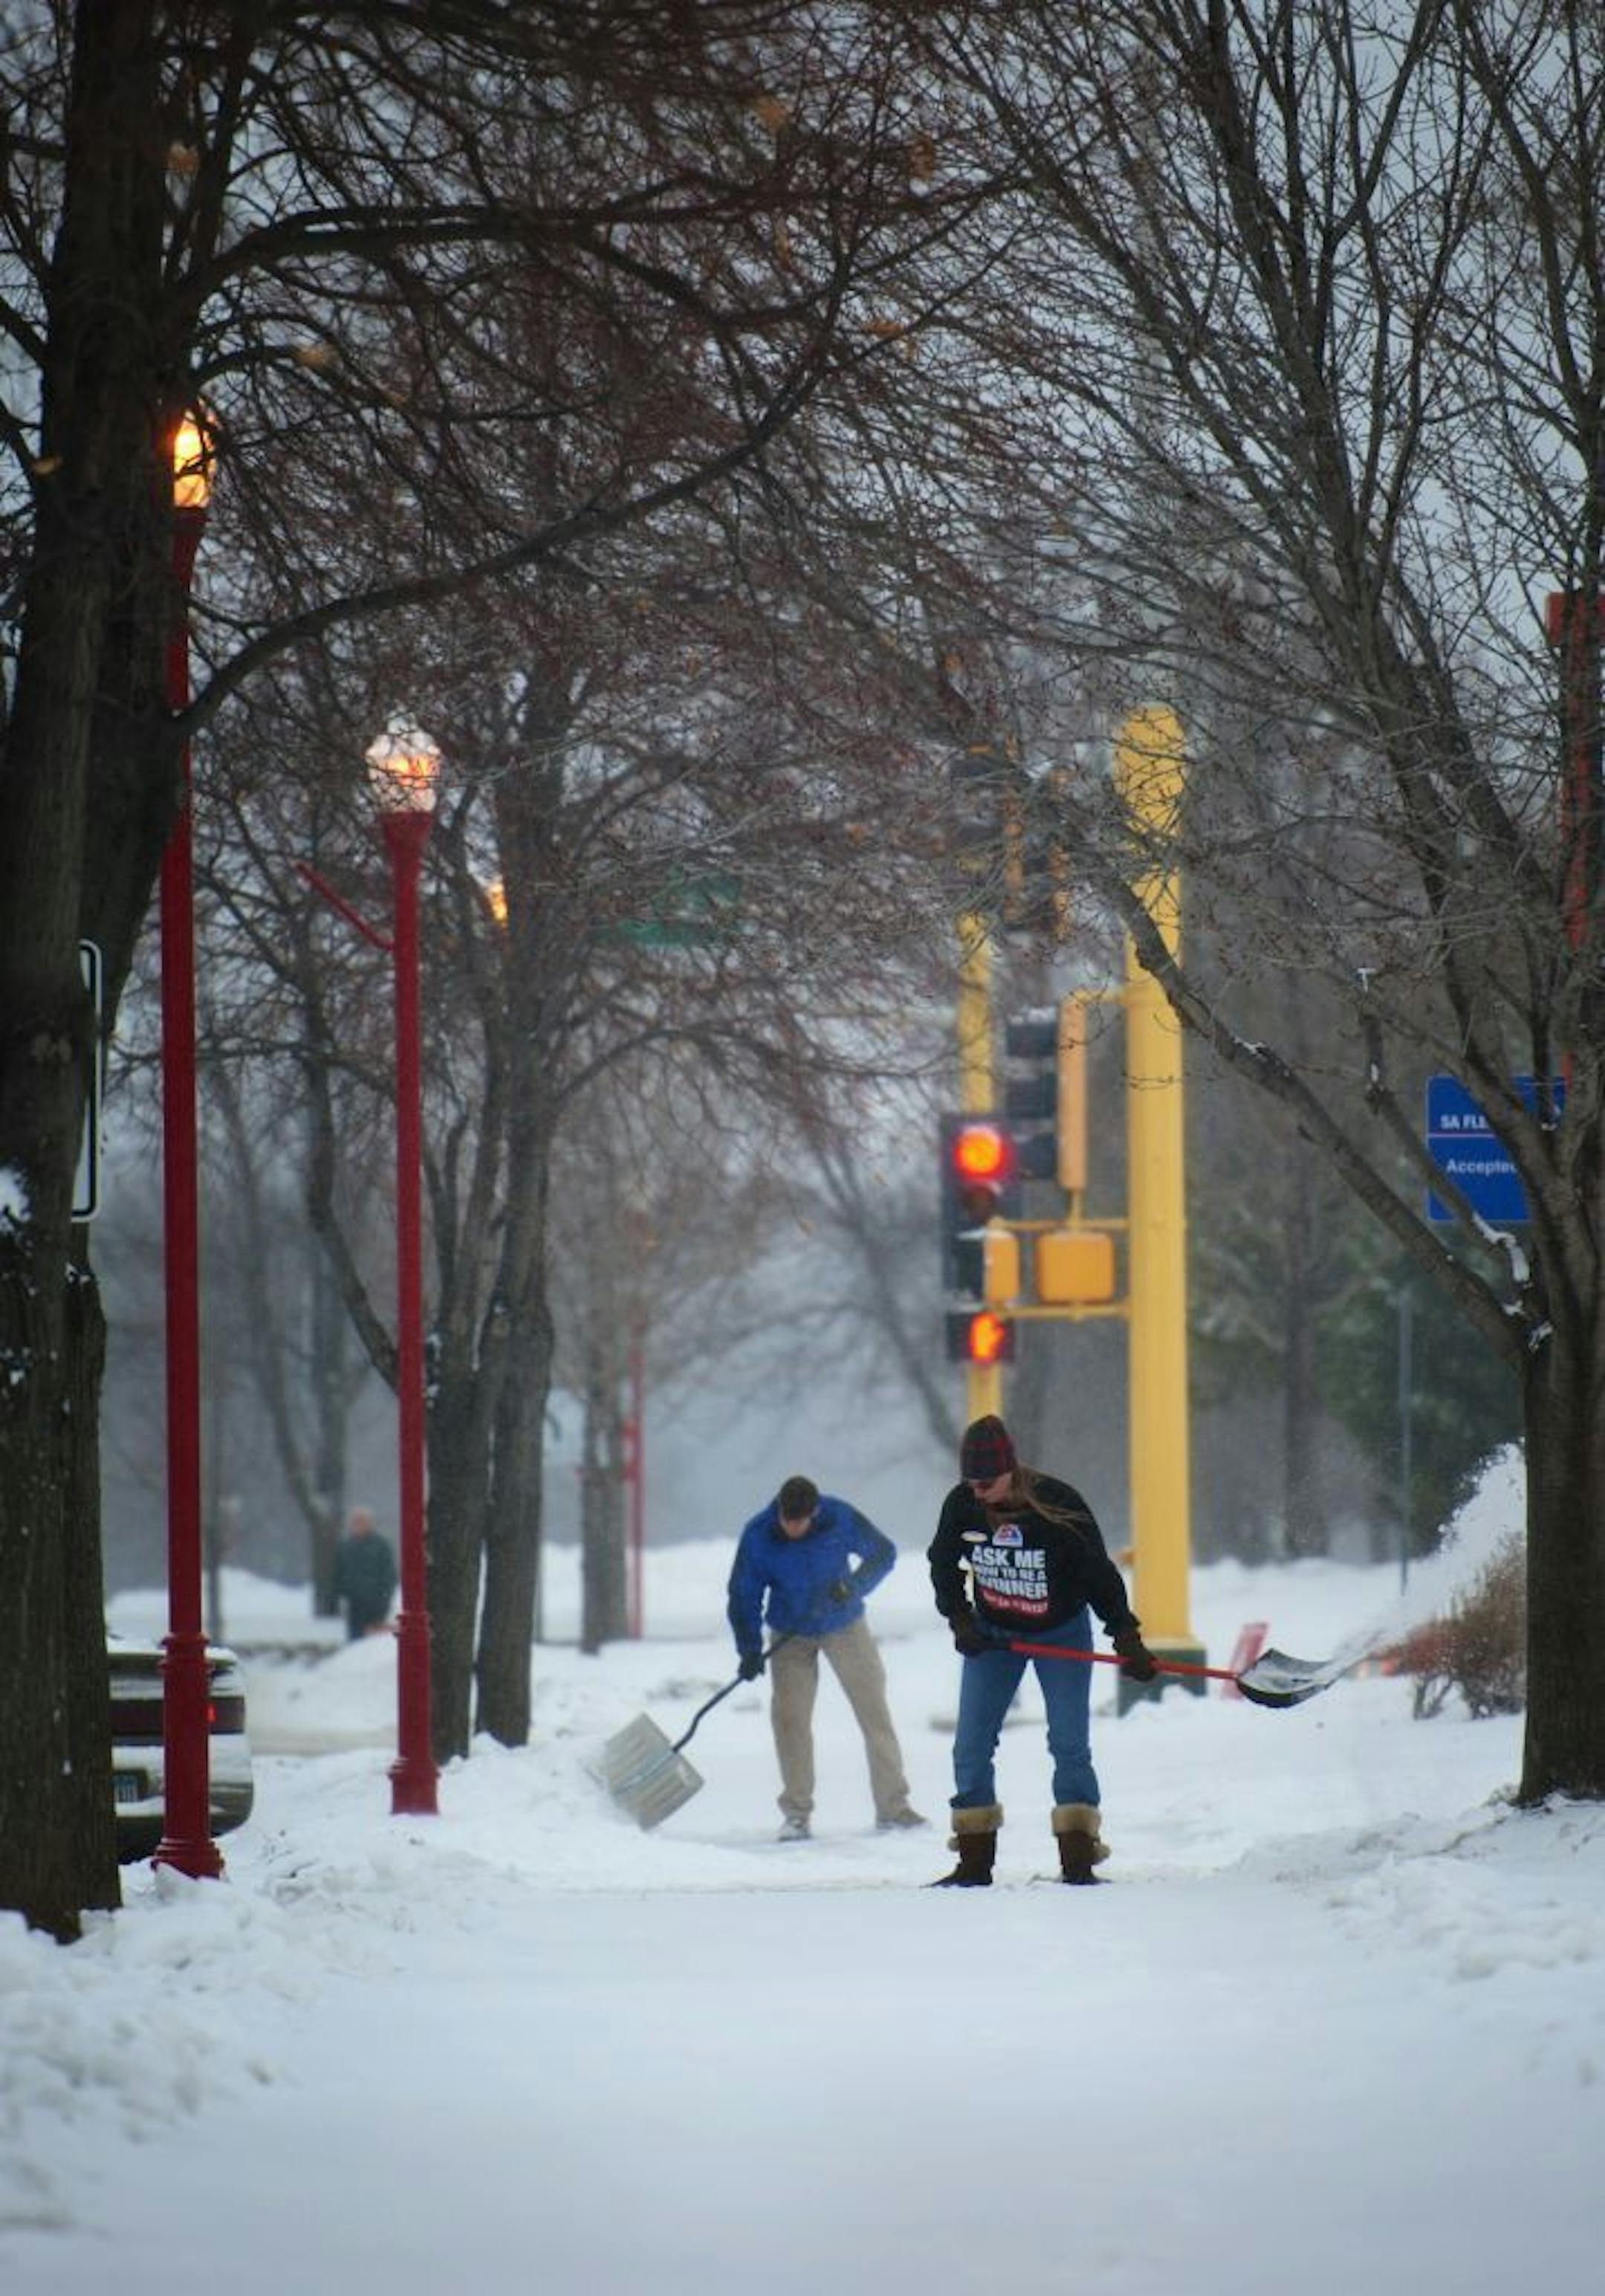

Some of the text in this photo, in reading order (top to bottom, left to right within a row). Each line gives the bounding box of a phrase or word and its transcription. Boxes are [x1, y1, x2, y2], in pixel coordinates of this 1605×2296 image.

[1440, 1114, 1460, 1131] SA
[972, 1545, 1045, 1569] ASK ME
[1002, 1568, 1016, 1579] TO
